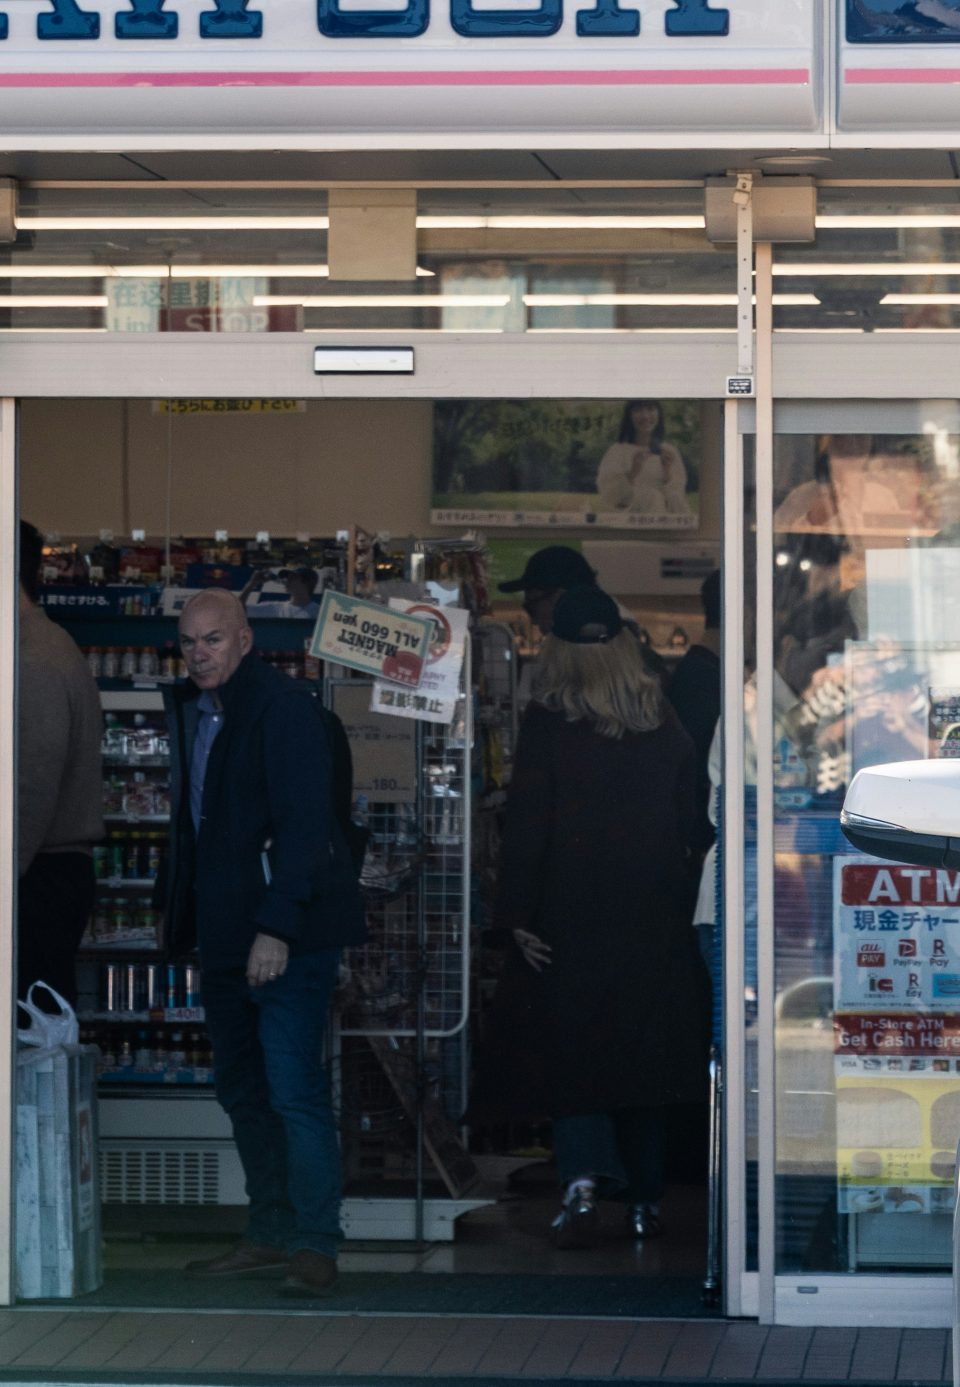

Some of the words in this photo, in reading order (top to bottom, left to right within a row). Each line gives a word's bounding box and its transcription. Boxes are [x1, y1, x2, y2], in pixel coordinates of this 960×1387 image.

[361, 620, 390, 640] 660
[394, 629, 422, 649] ALL
[336, 628, 400, 658] MAGNET
[867, 869, 960, 903] ATM
[861, 1018, 913, 1030] In-Store
[917, 1018, 946, 1030] ATM
[838, 1031, 868, 1047] Get
[872, 1031, 915, 1047] Cash
[921, 1031, 960, 1047] Here
